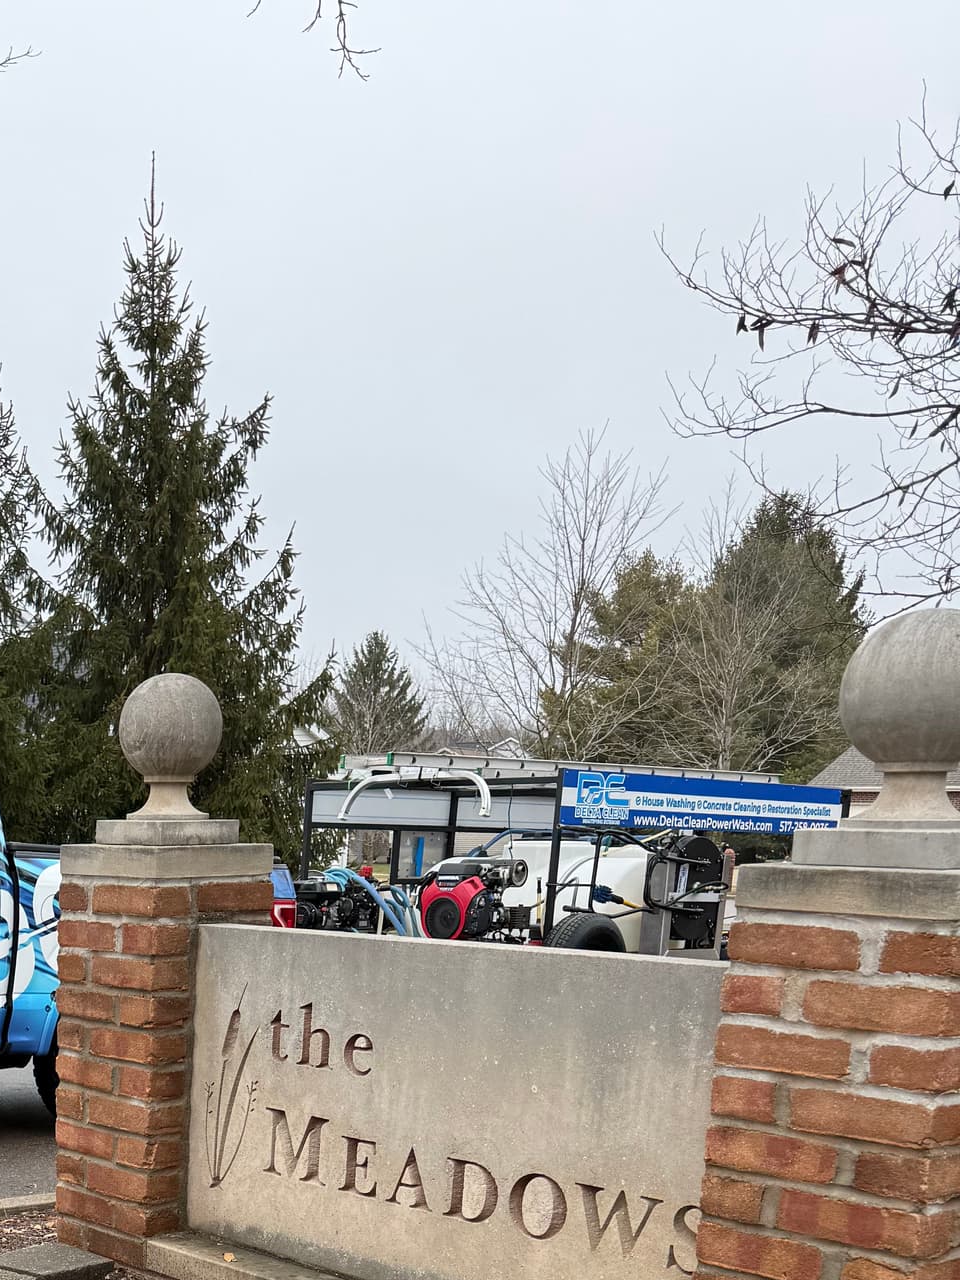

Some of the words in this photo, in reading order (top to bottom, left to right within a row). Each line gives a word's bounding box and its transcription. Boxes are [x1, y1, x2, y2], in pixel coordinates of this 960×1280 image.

[575, 806, 601, 819] DELTA
[602, 807, 629, 820] CLEAN
[642, 796, 665, 807] House
[665, 797, 696, 811] Washing
[702, 800, 732, 811] Concrete
[733, 801, 761, 814] Cleaning
[767, 803, 802, 815] Restoration
[803, 806, 831, 817] Specialist
[633, 815, 773, 832] www.DeltaCleanPowerWash.com
[269, 1001, 374, 1077] the
[262, 1106, 702, 1277] MEADOWS
